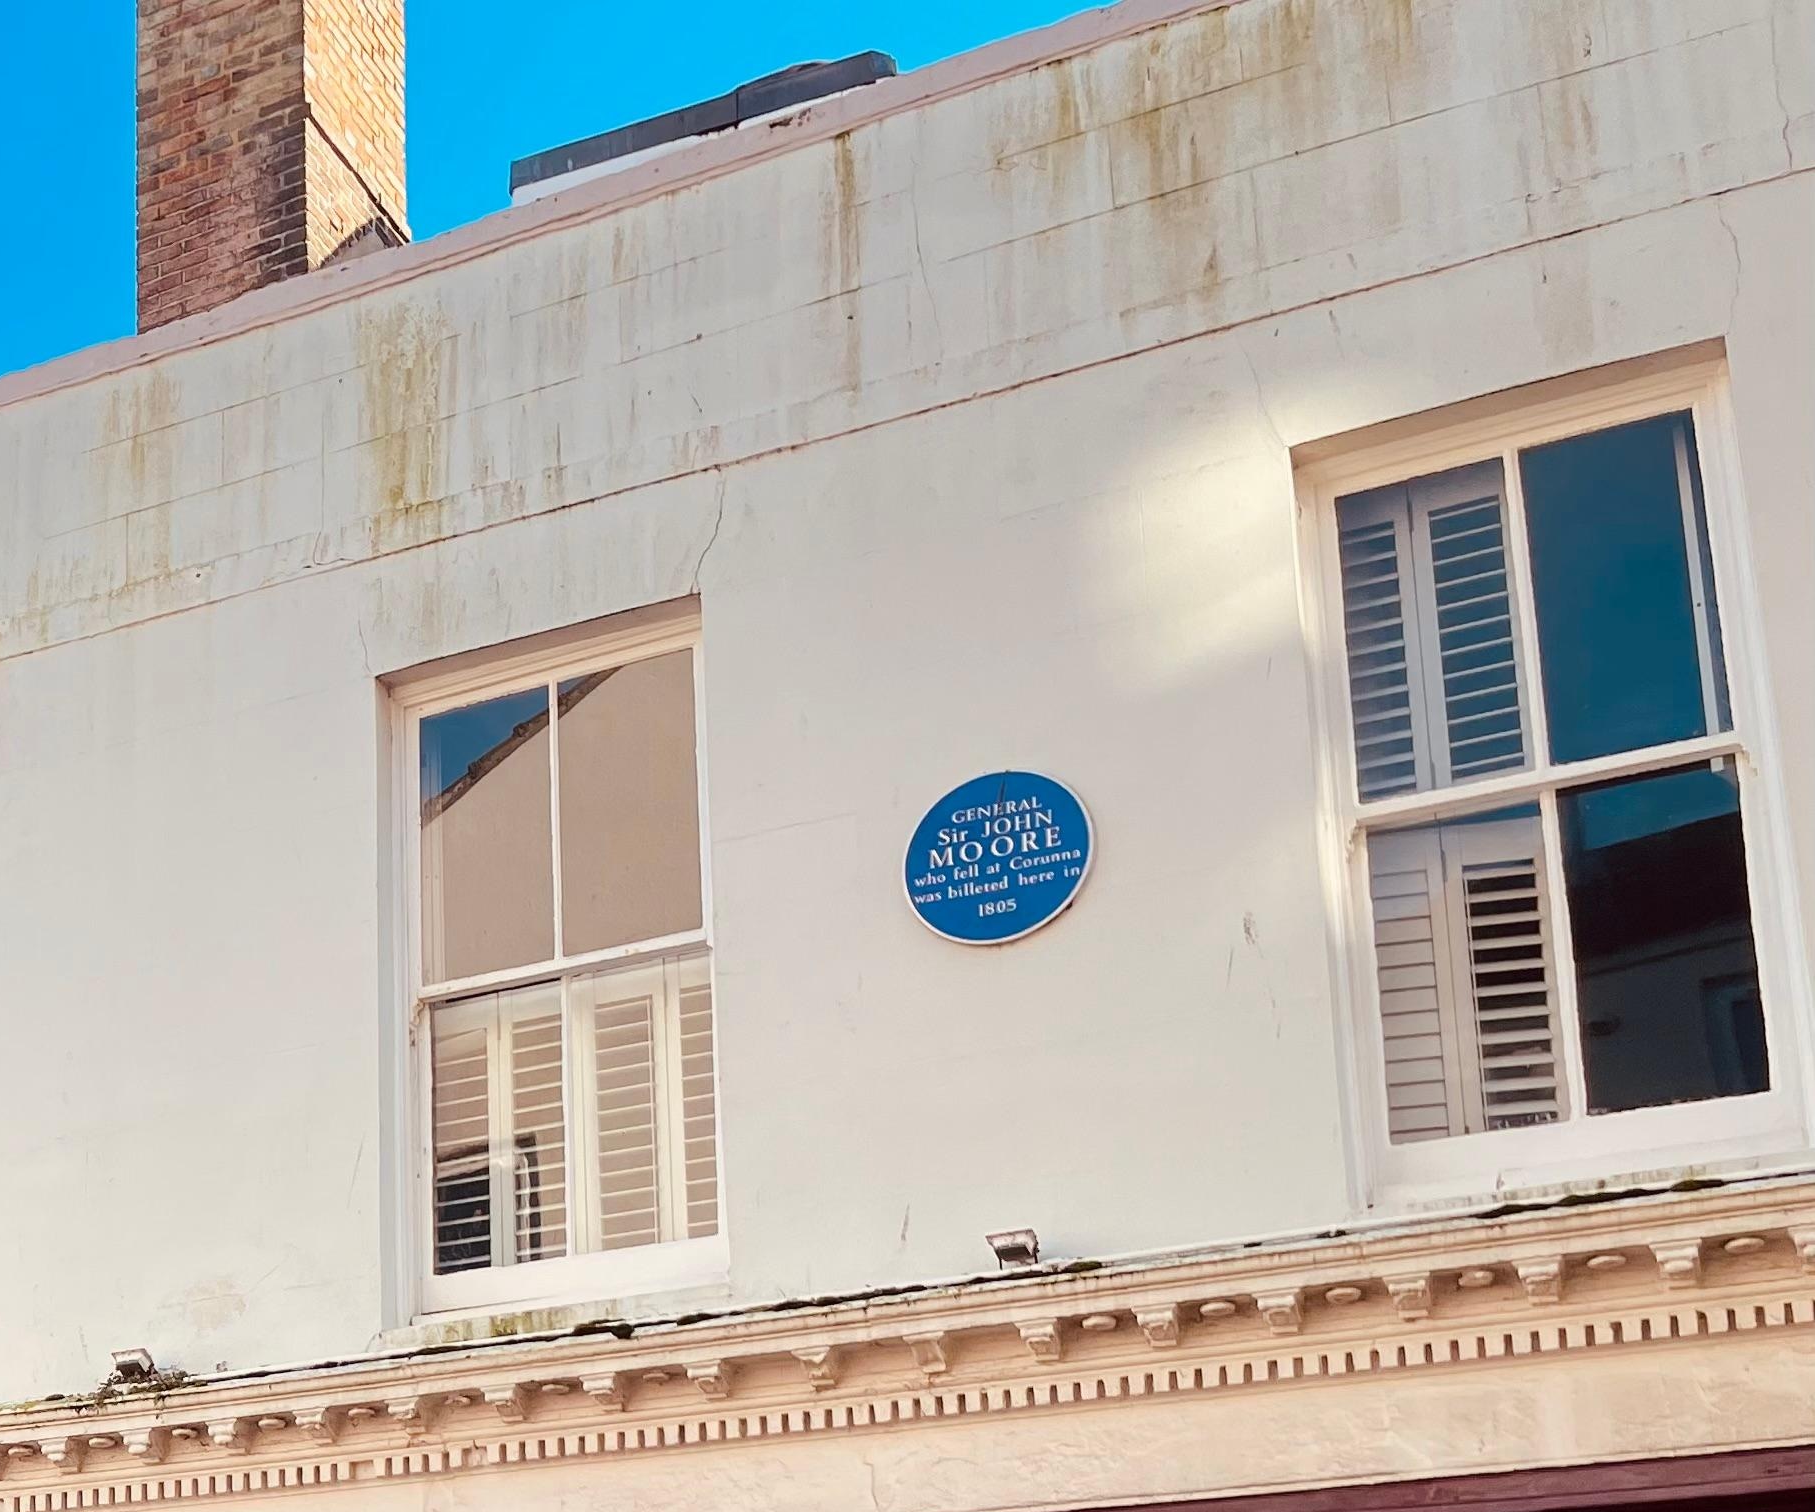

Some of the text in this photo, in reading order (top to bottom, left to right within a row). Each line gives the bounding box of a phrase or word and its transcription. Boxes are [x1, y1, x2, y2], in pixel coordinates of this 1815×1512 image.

[937, 809, 1052, 846] Sir JOHN
[951, 796, 1042, 824] GENERAL
[929, 826, 1061, 869] MOORE
[913, 865, 1081, 905] was billeted here in
[914, 849, 1081, 888] who fell at Corunna
[978, 899, 1017, 917] 1805
